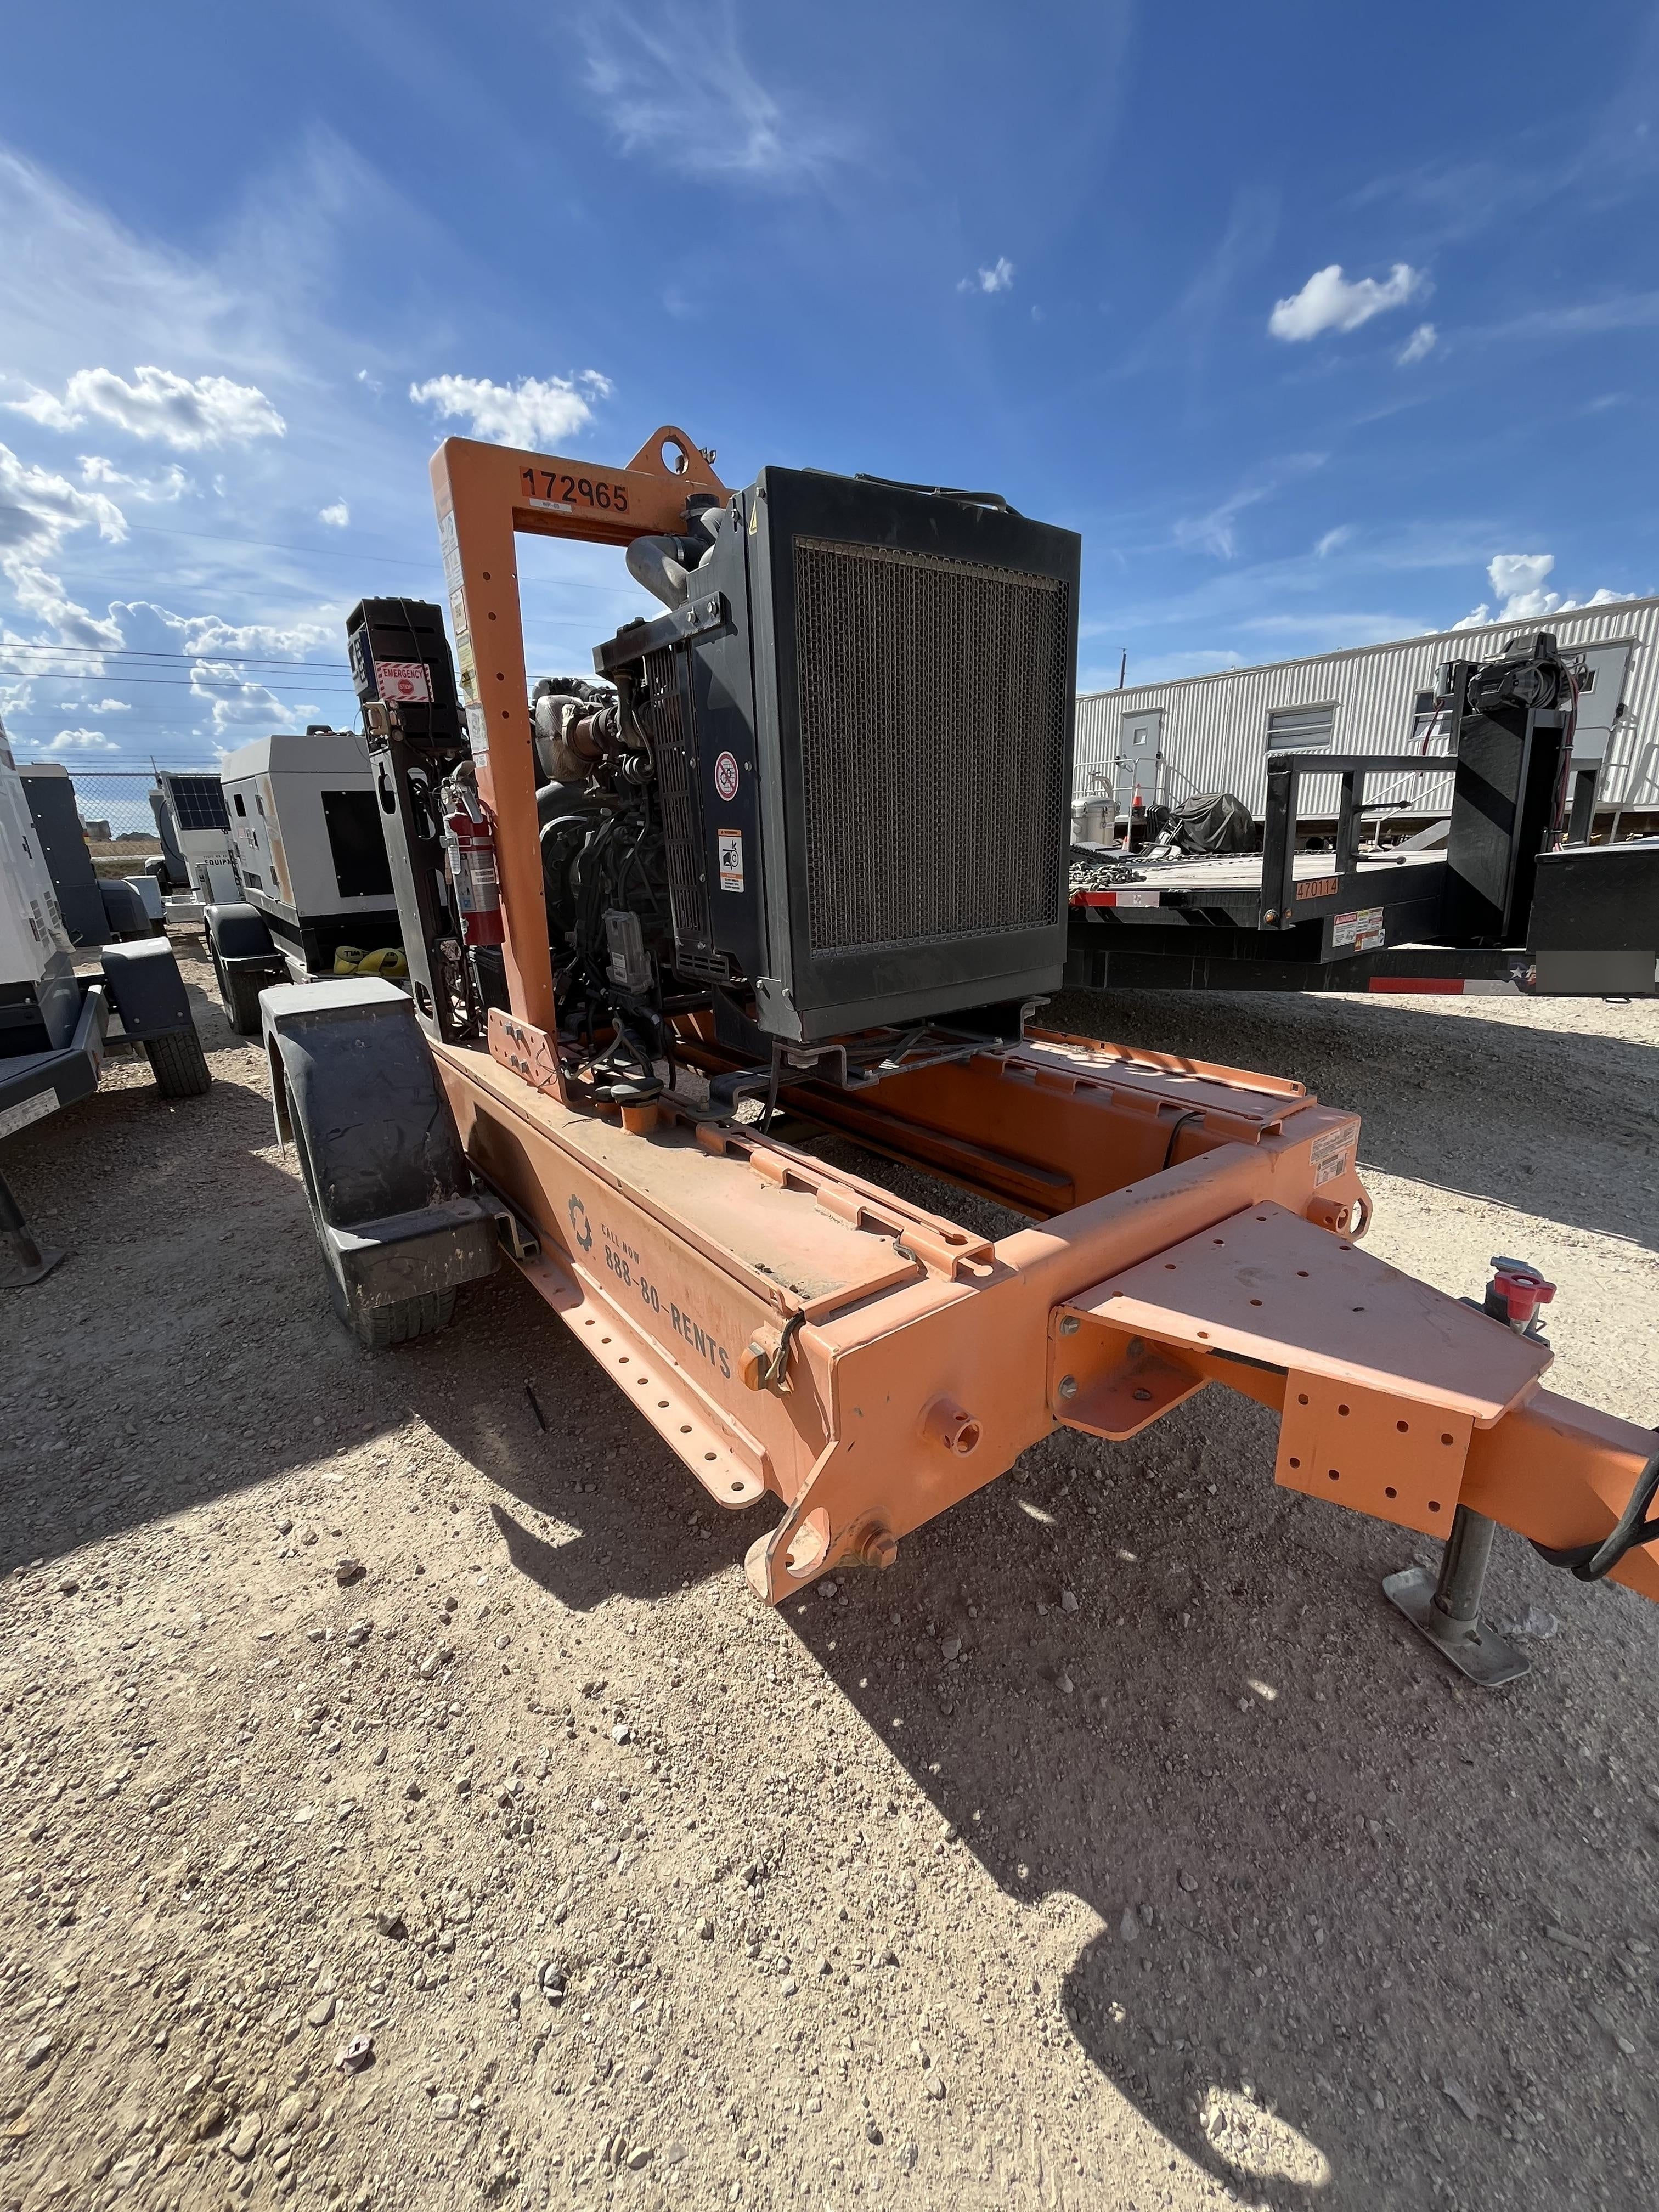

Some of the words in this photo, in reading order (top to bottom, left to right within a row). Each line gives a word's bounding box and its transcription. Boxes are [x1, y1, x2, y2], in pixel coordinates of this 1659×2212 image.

[523, 468, 628, 512] 172965
[383, 668, 422, 679] EMERGENCY
[1297, 878, 1337, 899] 470114
[601, 1223, 620, 1248] CALL
[622, 1241, 640, 1265] NOW
[605, 1244, 731, 1379] 888-80-RENTS
